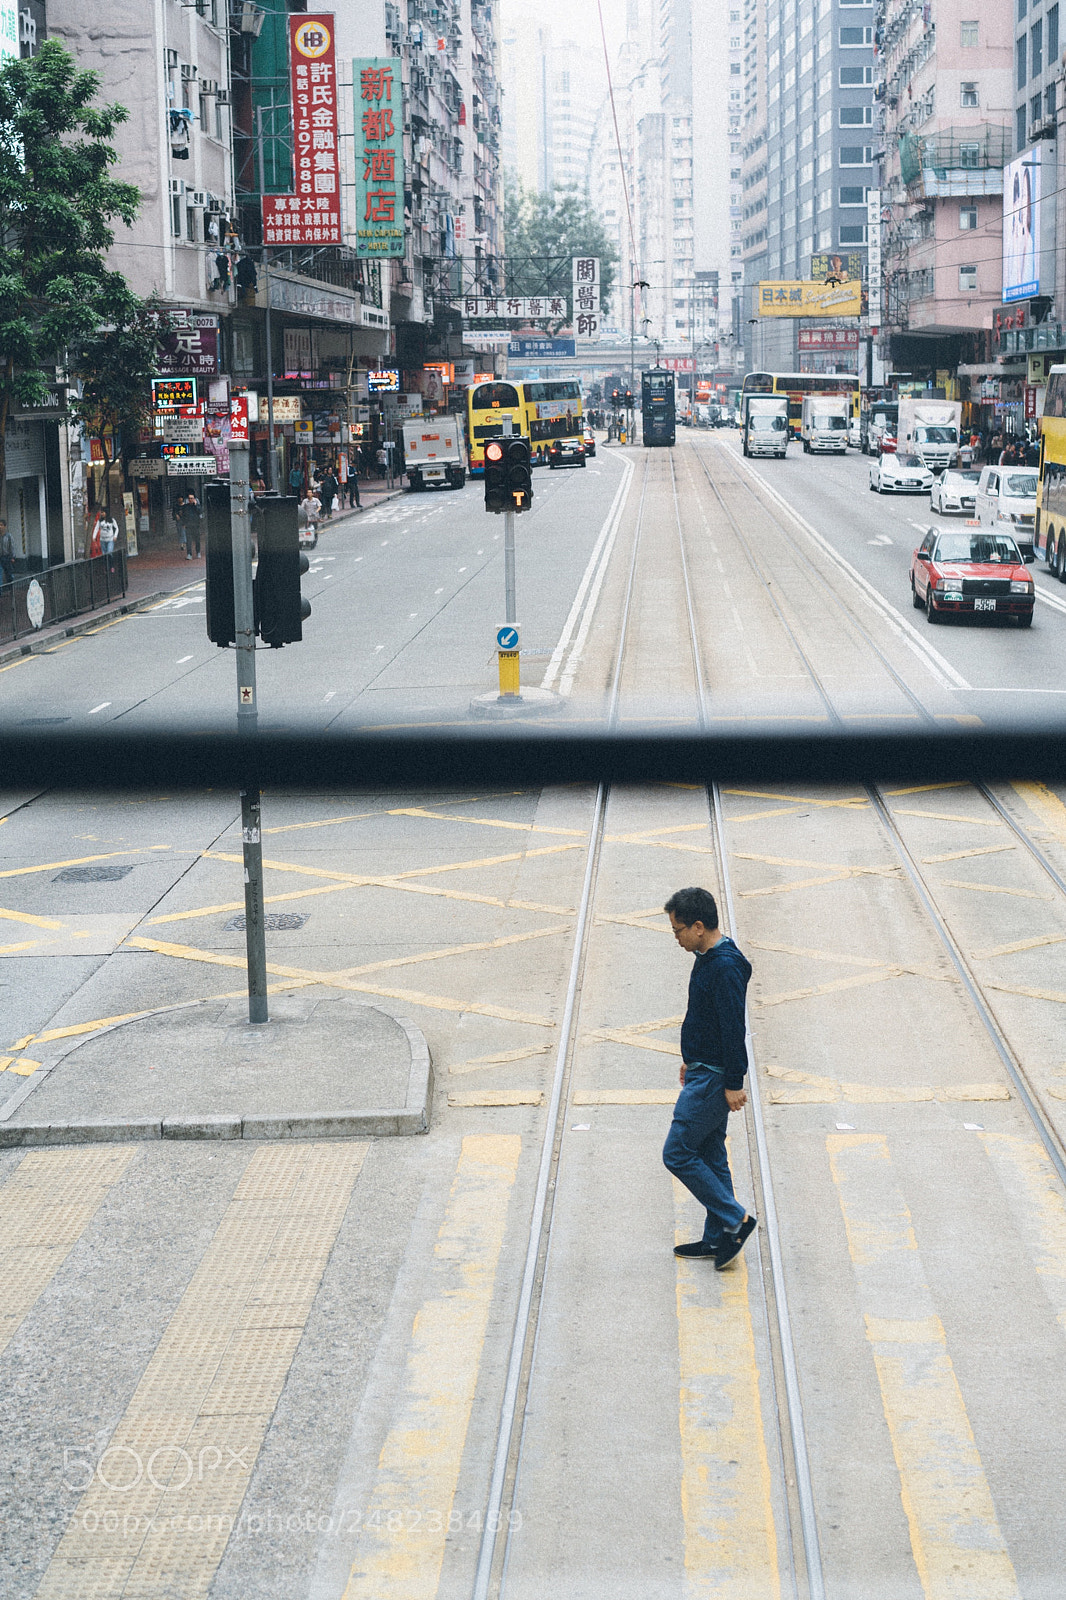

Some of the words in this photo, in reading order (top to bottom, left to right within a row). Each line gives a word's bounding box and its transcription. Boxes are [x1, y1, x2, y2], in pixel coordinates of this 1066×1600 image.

[304, 32, 323, 47] HB
[296, 64, 308, 90] 電話
[310, 62, 336, 194] 許氏金融集團
[298, 94, 313, 194] 31507888
[361, 66, 396, 221] 新都酒店
[274, 197, 330, 211] 專營大陸
[358, 229, 373, 238] NEW
[375, 228, 402, 237] CAPITAL
[367, 242, 389, 250] HOTEL
[762, 288, 803, 302] 日本城
[464, 298, 564, 316] 同興行醫藥
[509, 341, 520, 352] 租
[1032, 361, 1041, 372] P
[231, 416, 247, 428] 公司
